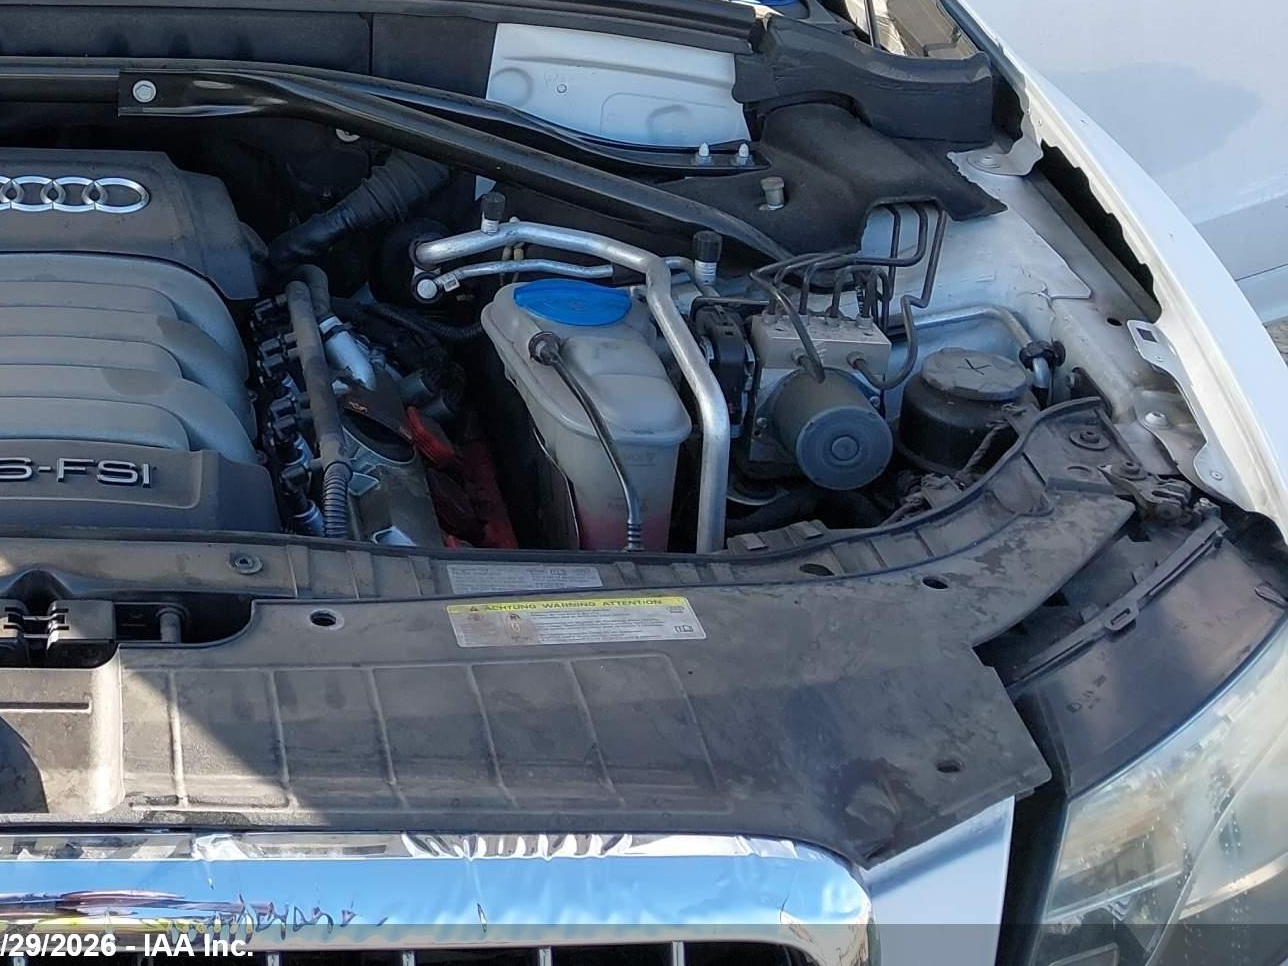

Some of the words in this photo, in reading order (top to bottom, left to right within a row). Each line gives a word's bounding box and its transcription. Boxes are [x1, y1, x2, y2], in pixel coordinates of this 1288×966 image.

[485, 603, 537, 612] ACHTUNG
[542, 601, 596, 609] WARNING
[602, 599, 662, 607] ATTENTION
